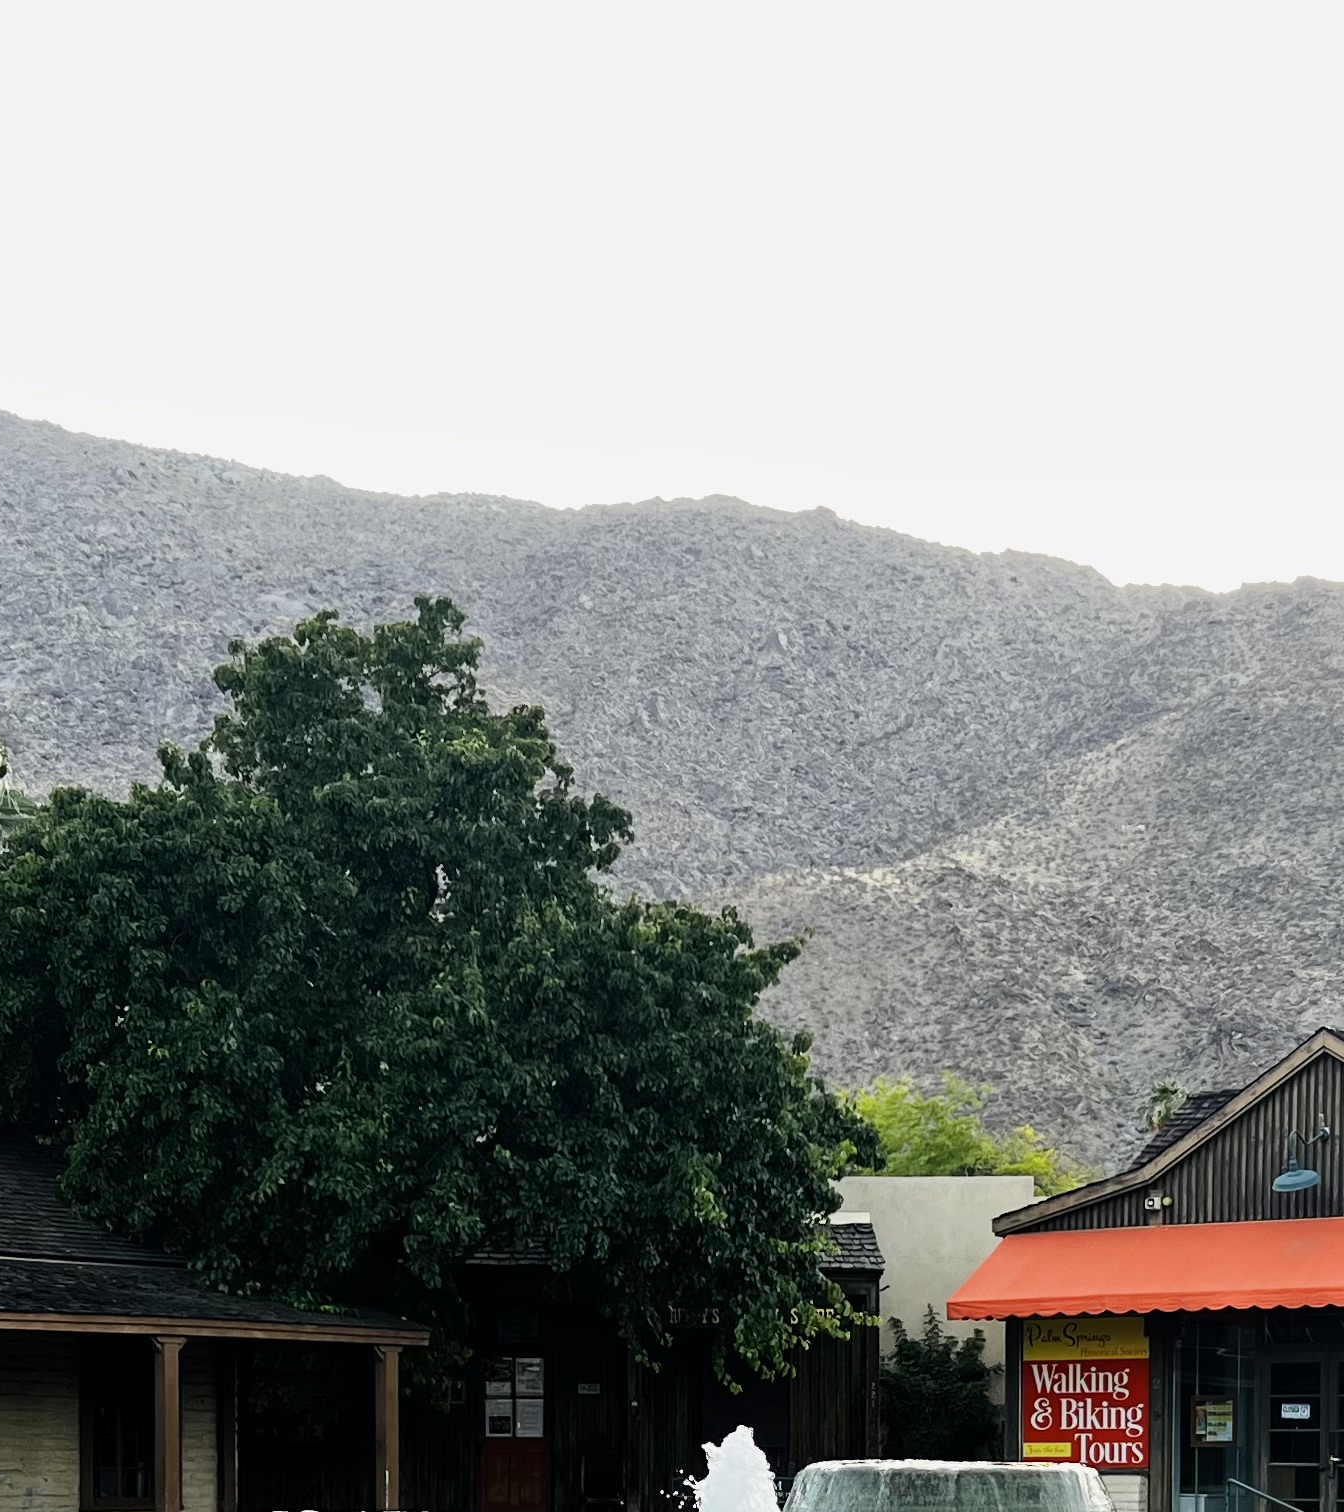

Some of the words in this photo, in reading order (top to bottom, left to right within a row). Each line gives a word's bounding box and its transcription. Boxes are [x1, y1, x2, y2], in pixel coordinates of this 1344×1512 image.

[1027, 1323, 1061, 1347] Palm
[1063, 1322, 1111, 1350] Springs
[1031, 1363, 1130, 1400] Walking
[1031, 1397, 1052, 1430] &
[1059, 1398, 1144, 1437] Biking
[1074, 1433, 1144, 1464] Tours
